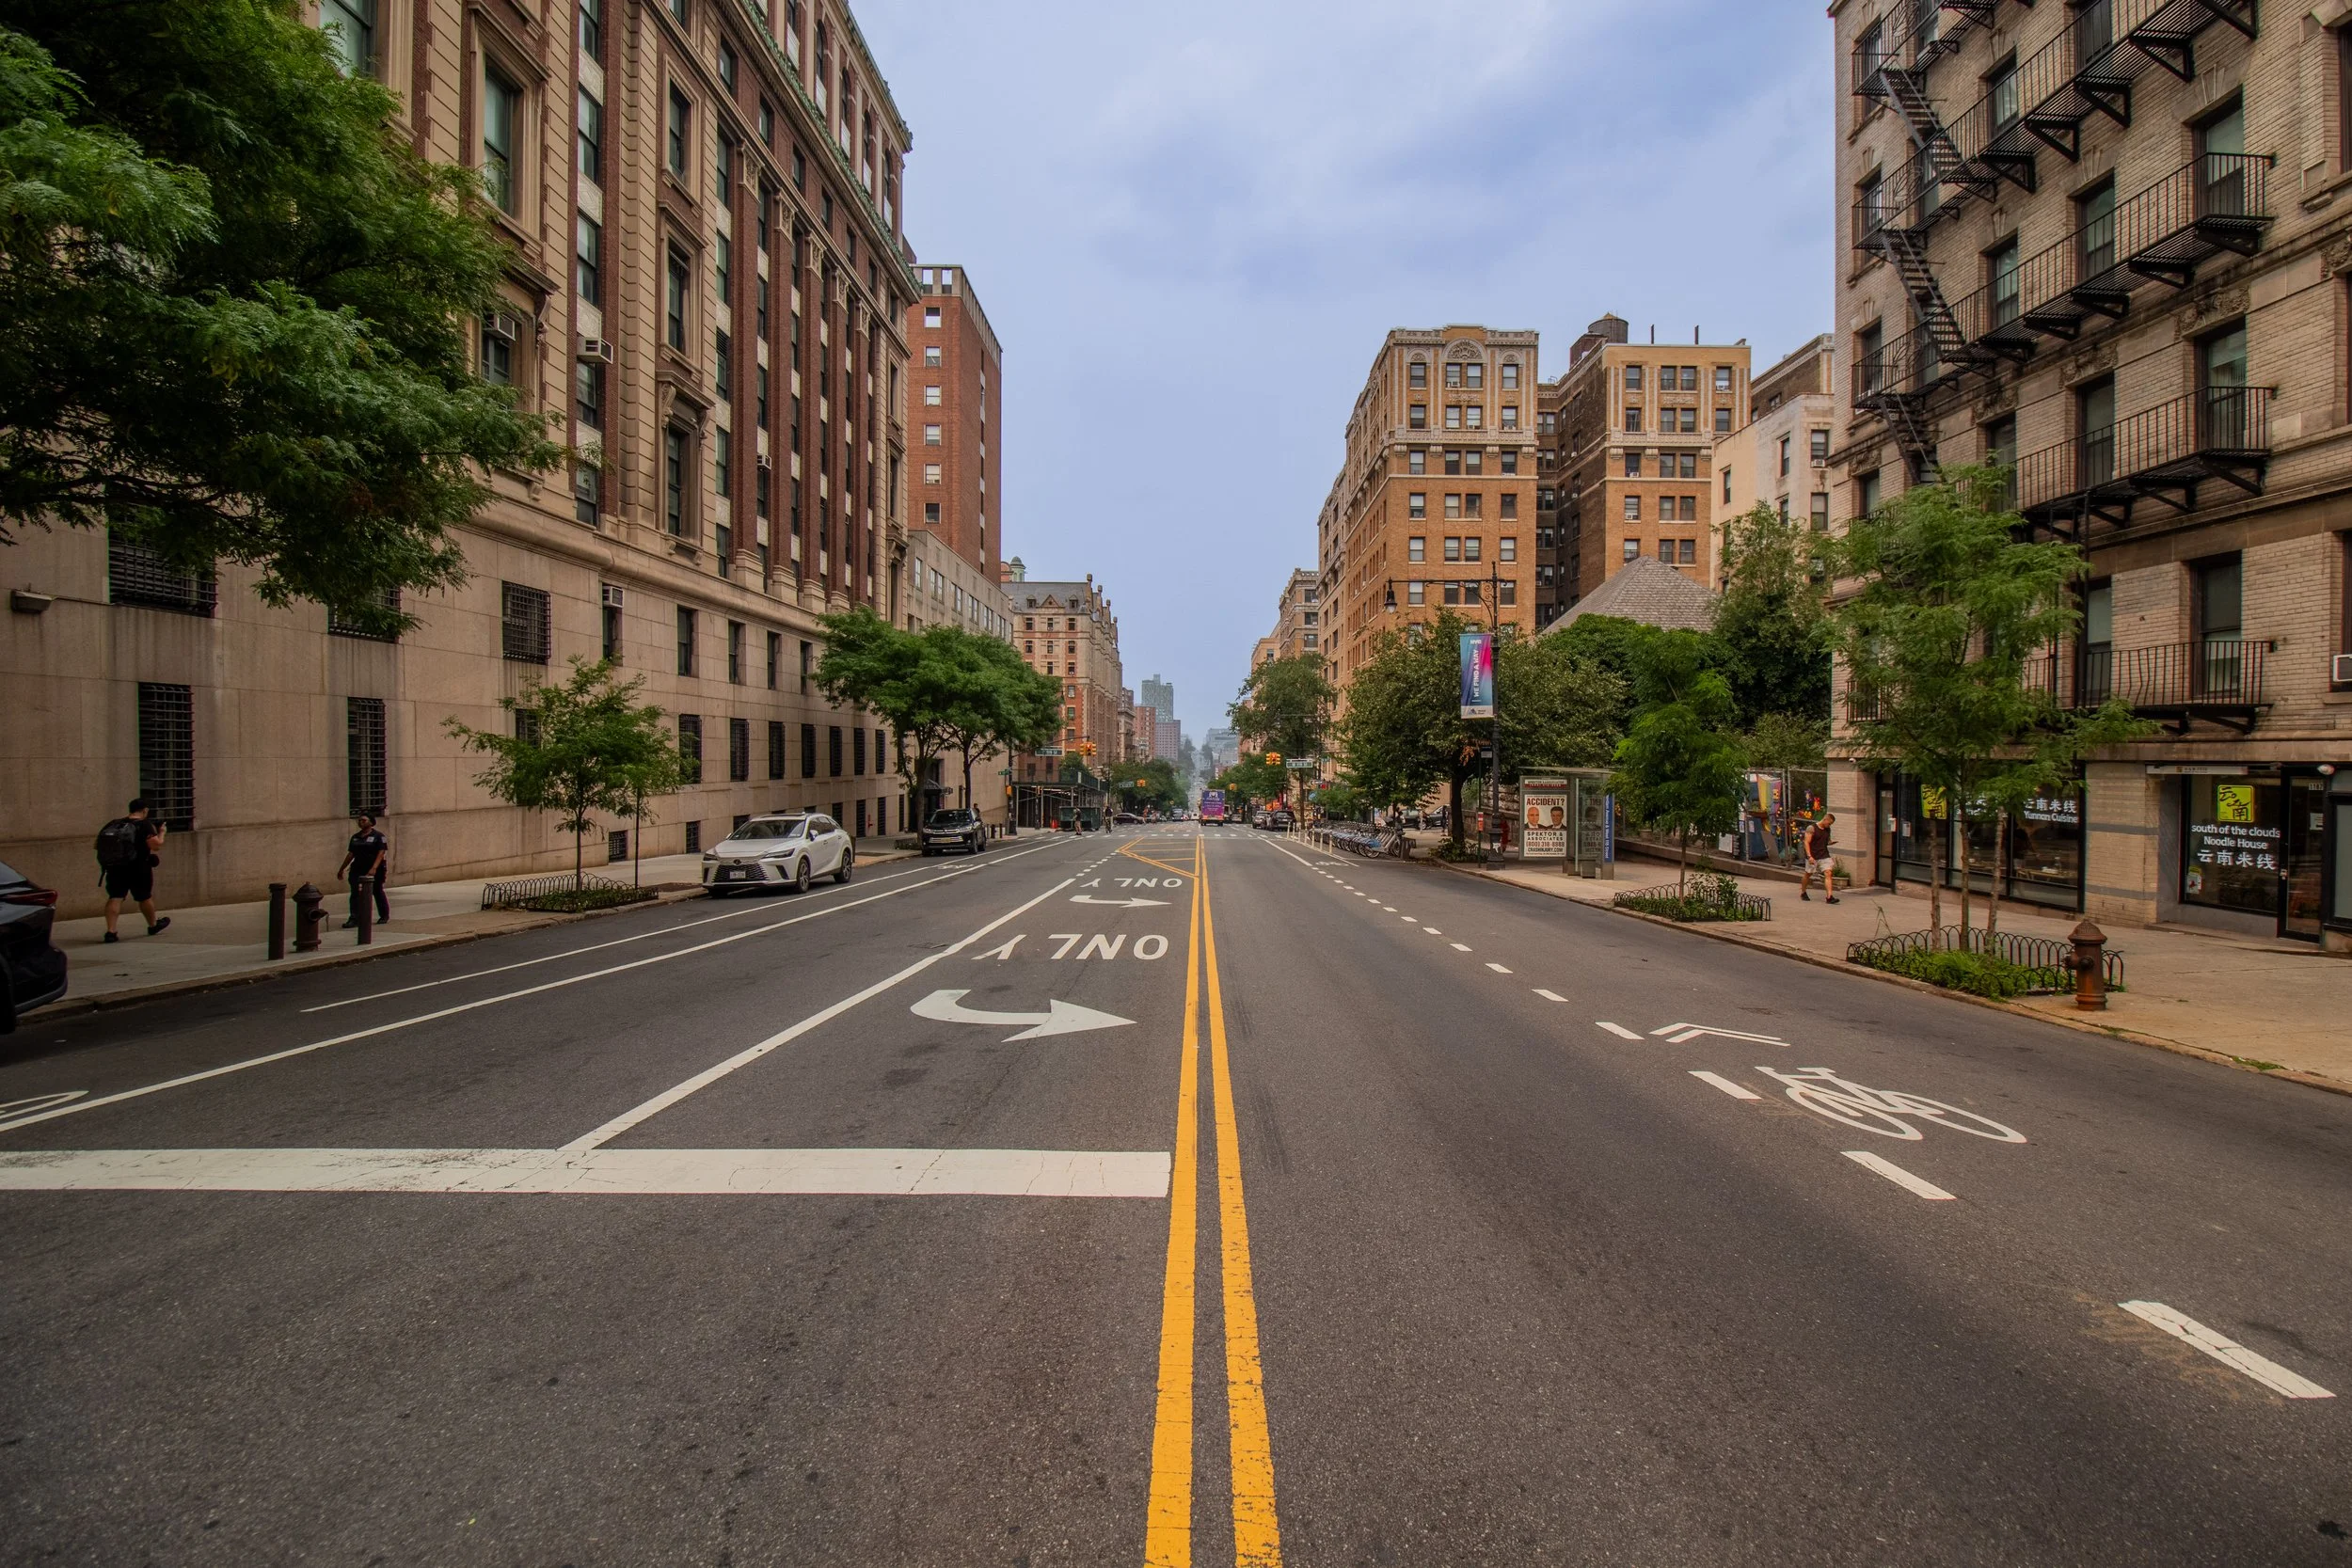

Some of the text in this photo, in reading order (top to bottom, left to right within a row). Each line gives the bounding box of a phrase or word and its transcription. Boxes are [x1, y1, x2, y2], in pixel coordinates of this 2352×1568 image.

[1473, 688, 1480, 697] WE
[2024, 810, 2078, 823] Yunnan Cuisine
[2191, 824, 2281, 838] south of the clouds
[2203, 836, 2268, 849] Noodle House
[2197, 849, 2277, 870] 云南米线
[1080, 878, 1183, 888] ONLY
[970, 934, 1169, 960] ONLY
